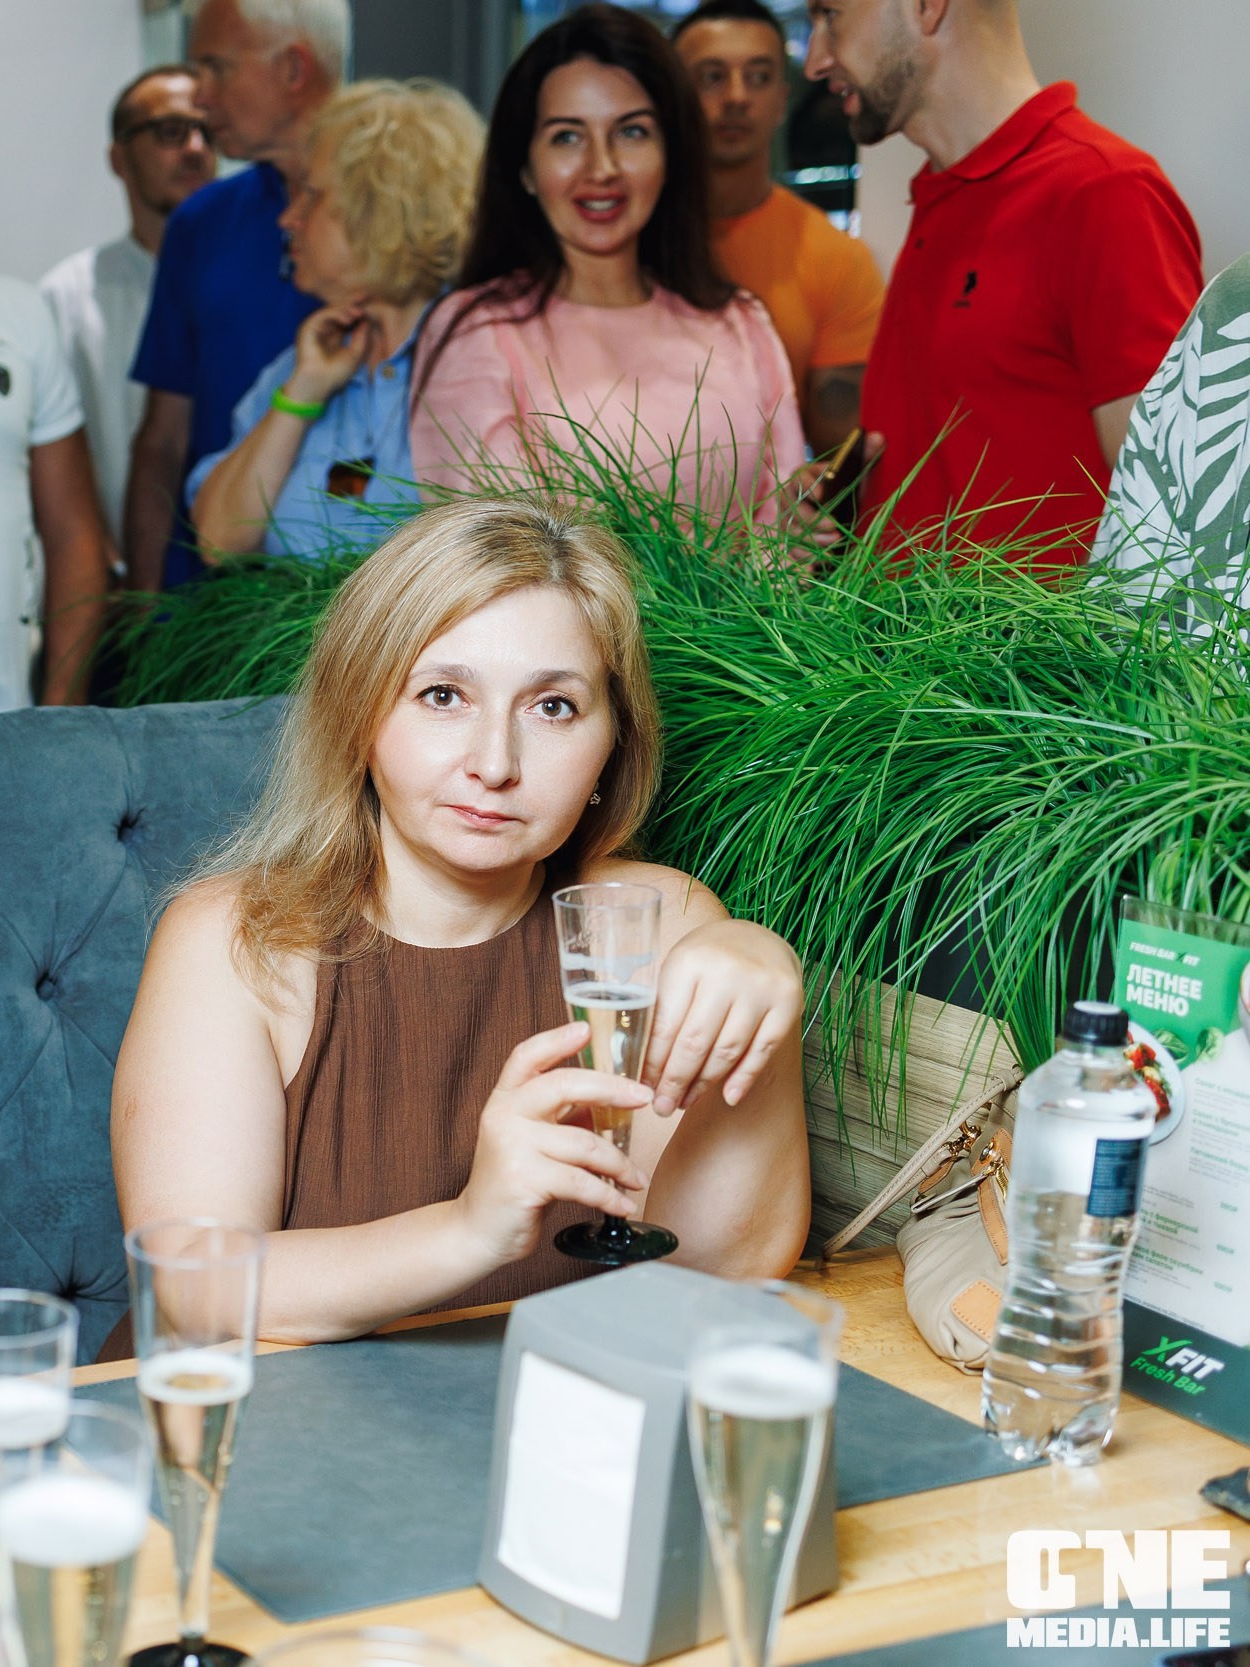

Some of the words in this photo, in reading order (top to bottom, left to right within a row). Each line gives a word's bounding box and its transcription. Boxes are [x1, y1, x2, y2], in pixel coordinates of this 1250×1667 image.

[1126, 963, 1203, 1000] ЛЕТНЕЕ
[1126, 984, 1190, 1017] МЕНЮ
[1130, 1357, 1177, 1383] Fresh
[1173, 1375, 1207, 1396] Bar
[1141, 1336, 1225, 1380] XFIT
